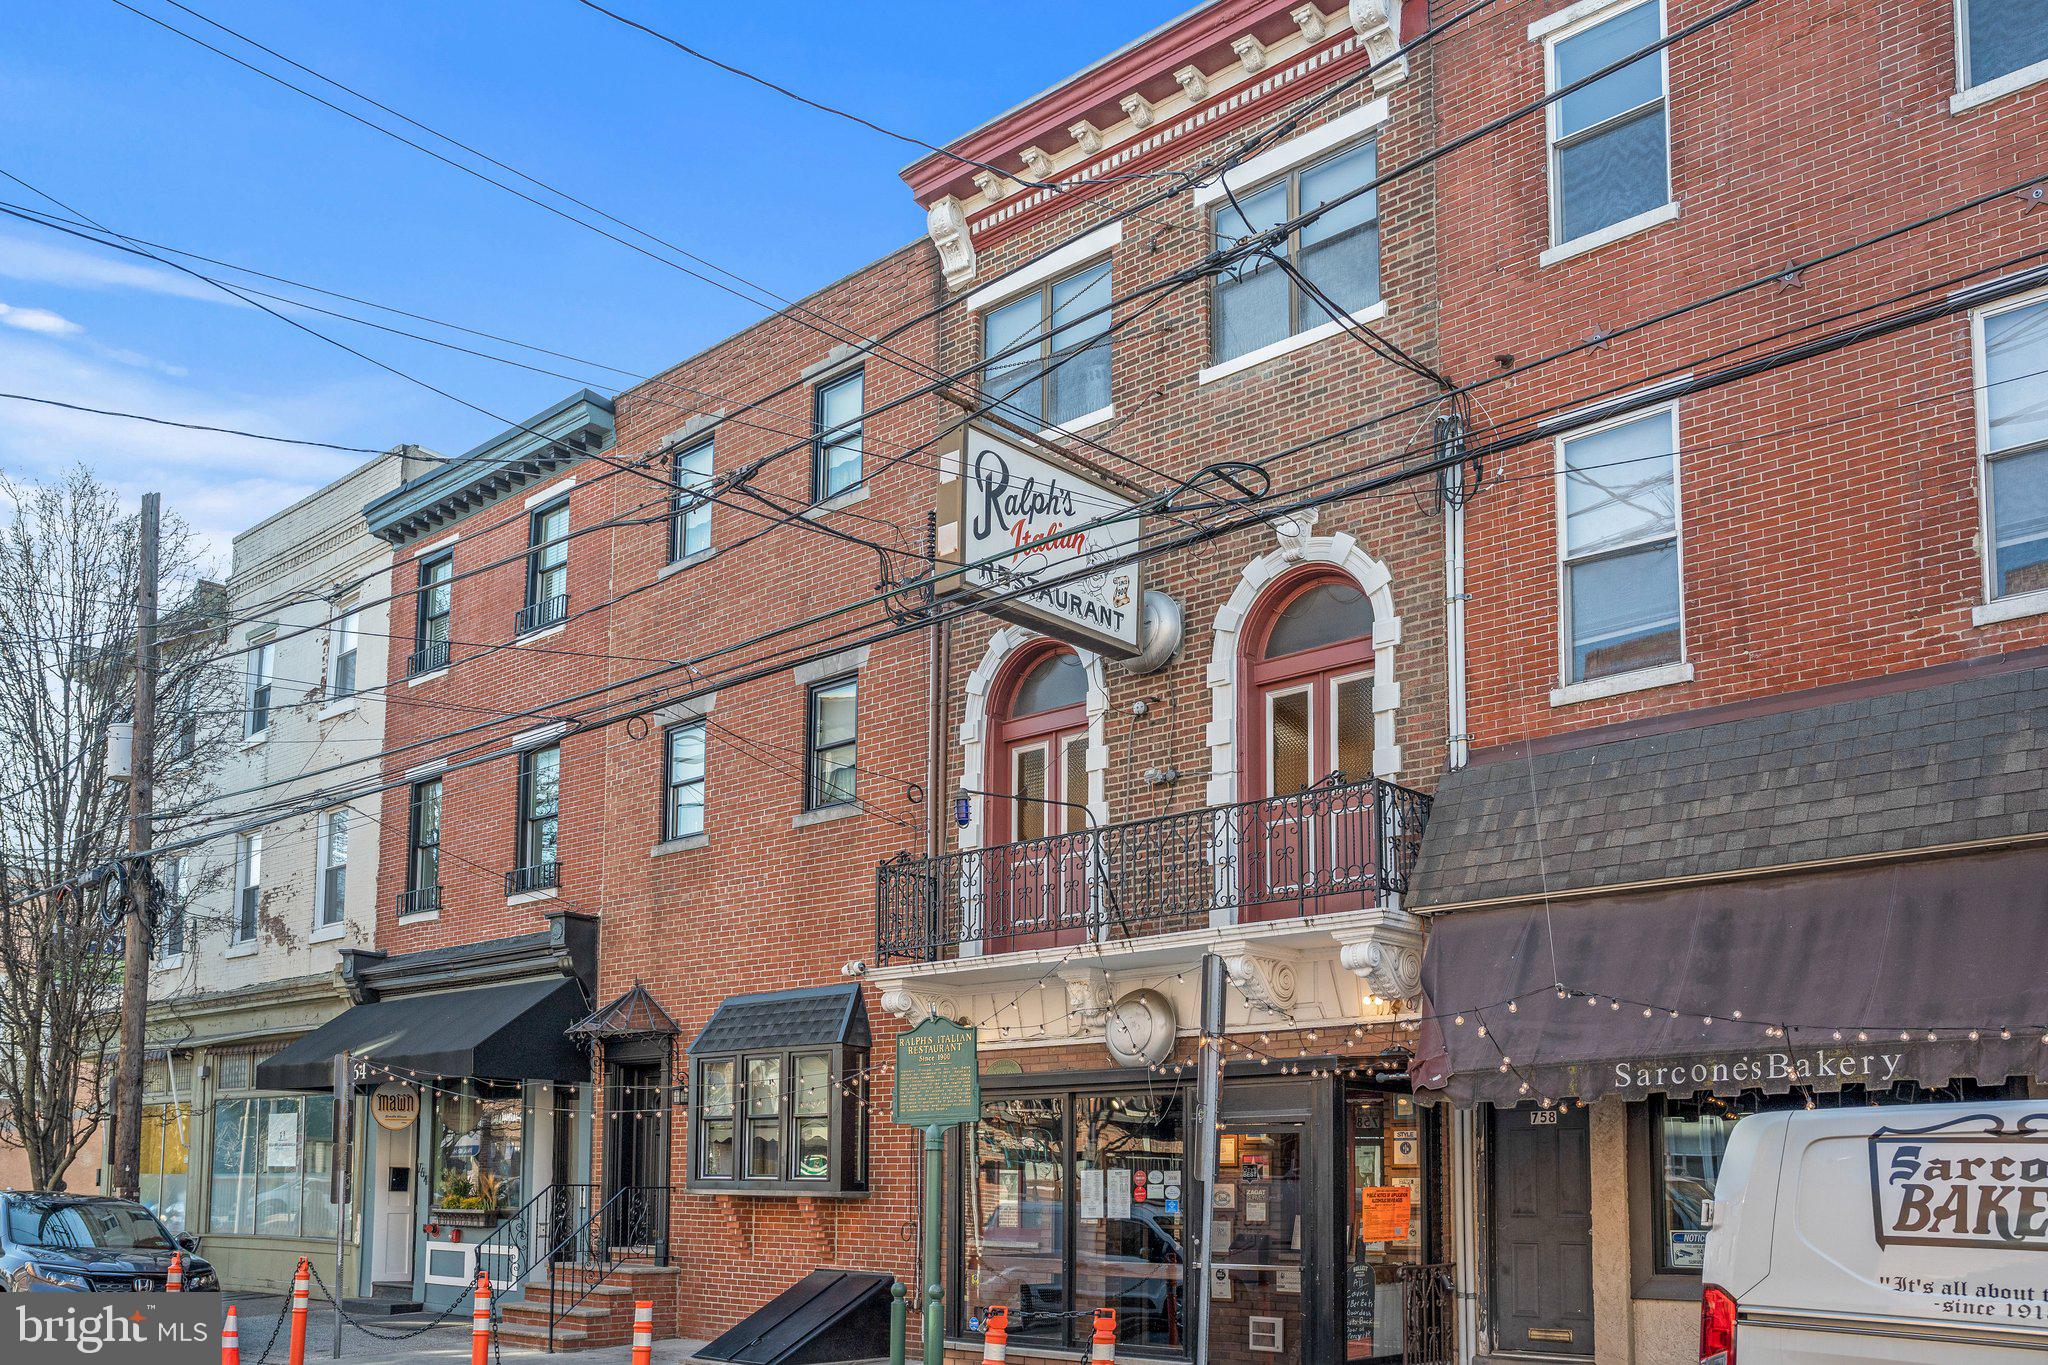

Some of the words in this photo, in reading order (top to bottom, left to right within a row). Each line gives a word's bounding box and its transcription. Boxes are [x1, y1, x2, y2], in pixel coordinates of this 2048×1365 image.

[973, 450, 1076, 541] Ralph's
[1010, 518, 1086, 564] Italian
[908, 1043, 963, 1055] RESTAURANT
[937, 1033, 973, 1044] ITALIAN
[937, 1053, 951, 1061] 1900
[1766, 1050, 1902, 1081] Bakery
[1531, 1111, 1556, 1124] 758
[1889, 1146, 2048, 1186] Sarco
[1892, 1184, 2048, 1242] BAKE
[1879, 1276, 1934, 1295] "It's
[1941, 1281, 1968, 1297] all
[1975, 1283, 2035, 1302] about
[2006, 1303, 2048, 1320] 191
